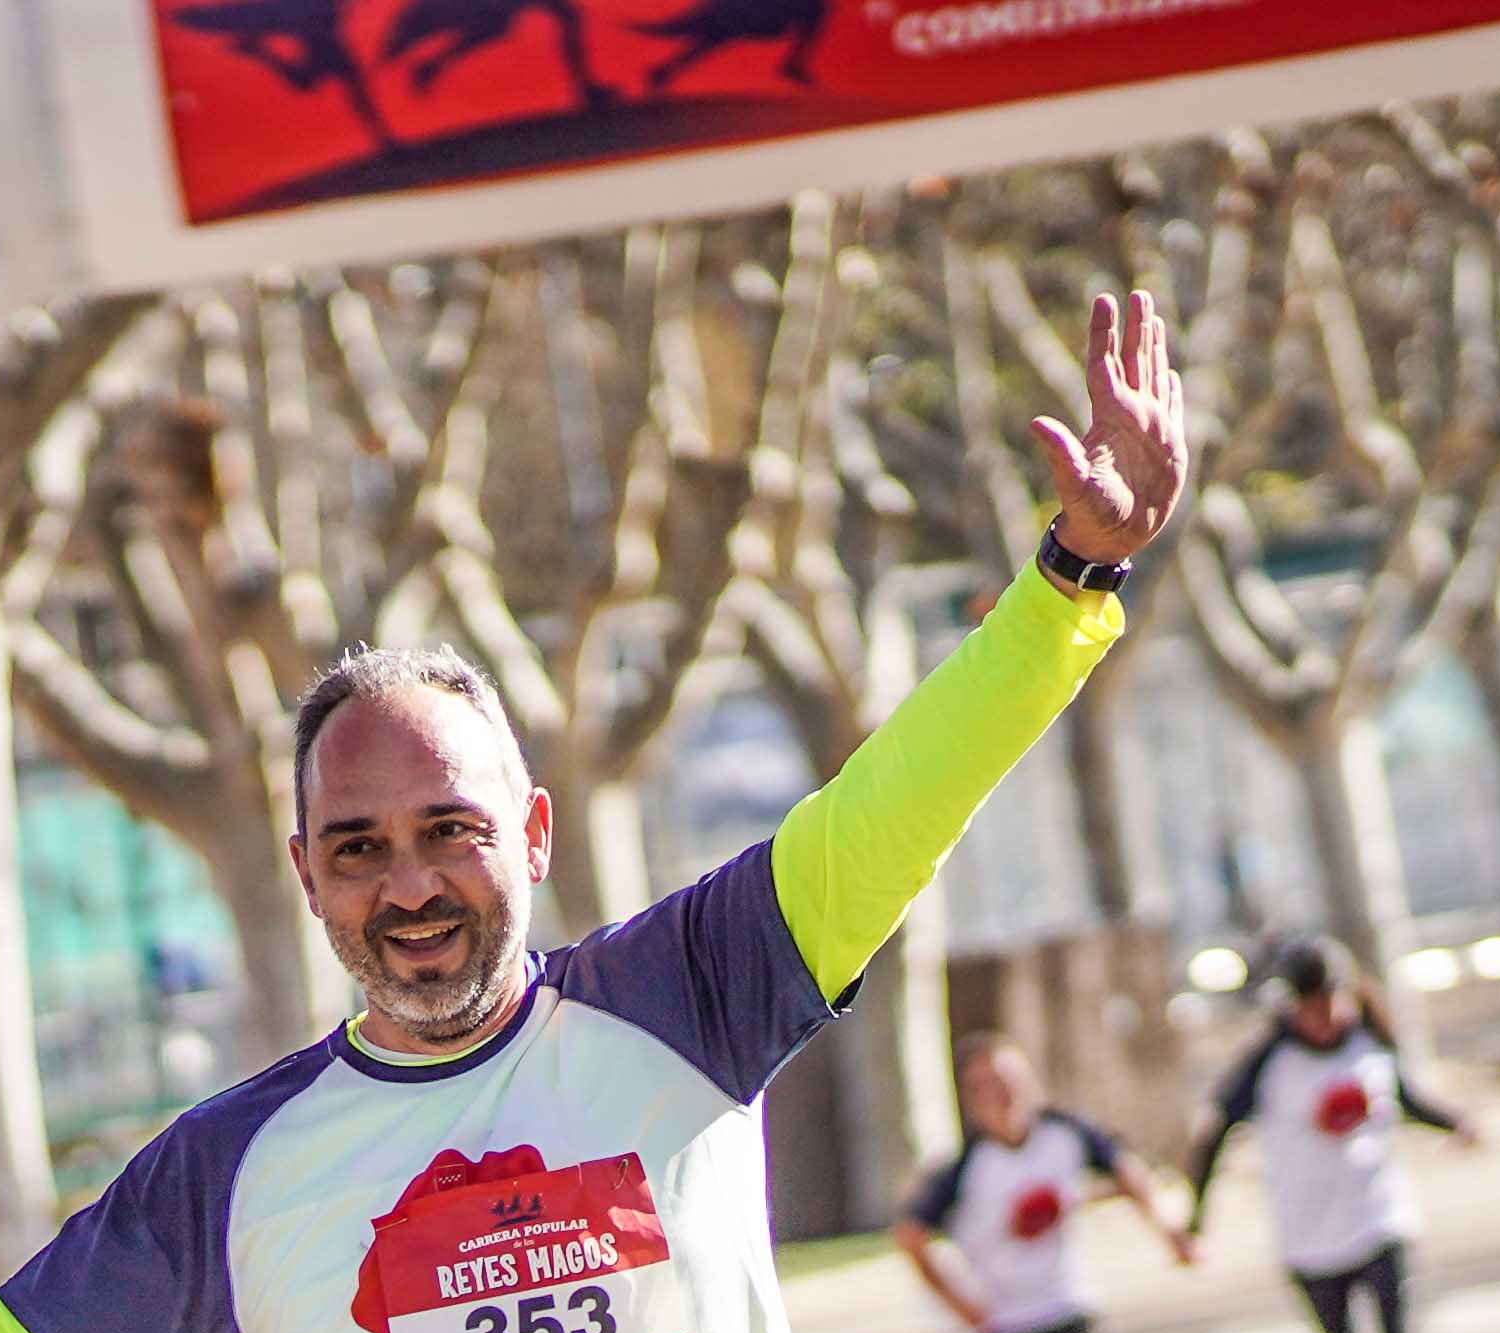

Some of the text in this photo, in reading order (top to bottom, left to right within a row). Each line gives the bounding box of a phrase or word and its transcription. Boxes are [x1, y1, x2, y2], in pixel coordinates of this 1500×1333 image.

[458, 1218, 589, 1253] CARRERA POPULAR
[436, 1232, 619, 1300] REYES MAGOS
